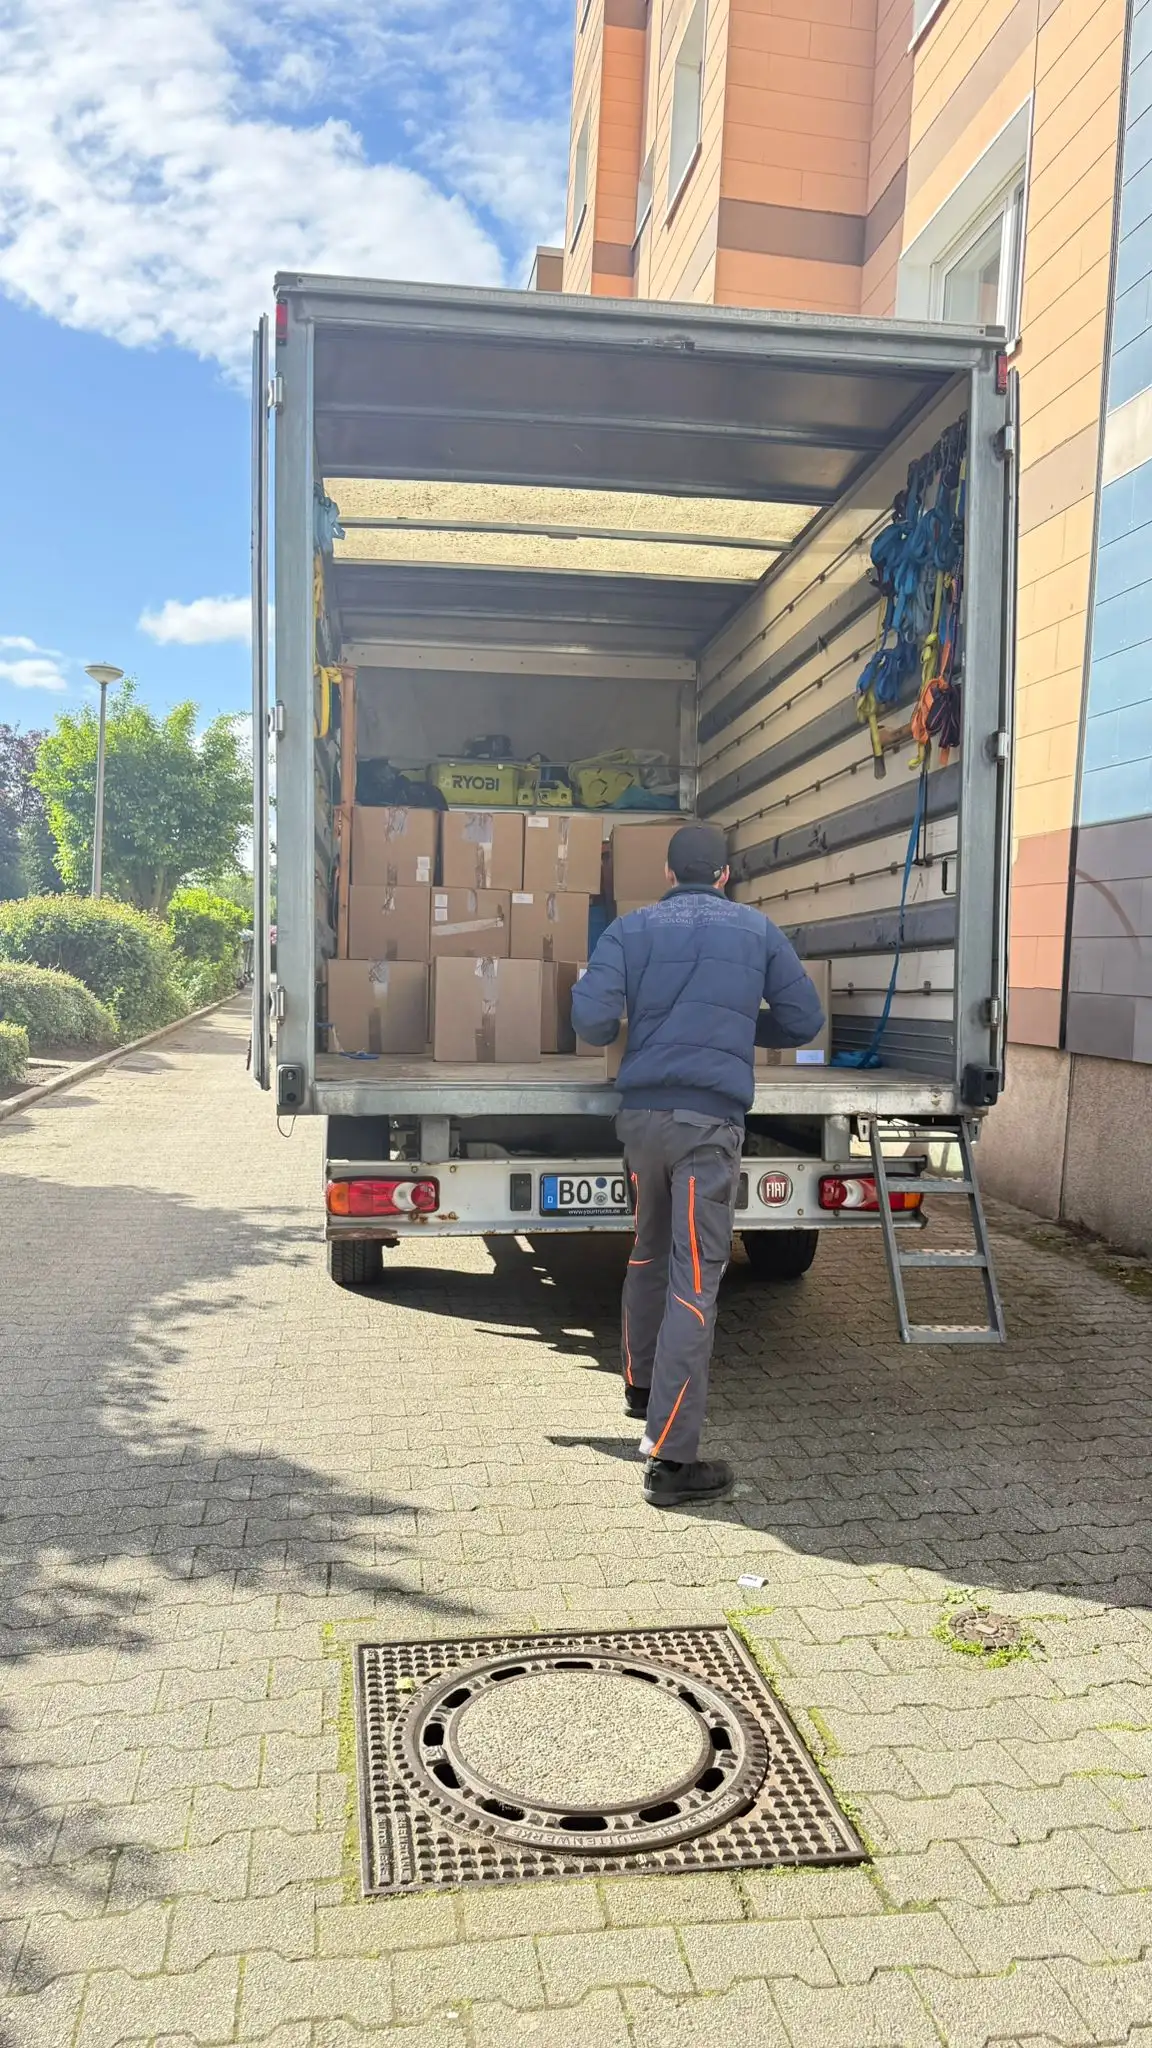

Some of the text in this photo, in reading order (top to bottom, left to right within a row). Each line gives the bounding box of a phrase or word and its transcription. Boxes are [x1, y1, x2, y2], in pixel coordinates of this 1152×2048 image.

[451, 774, 500, 792] RYOBI
[547, 1179, 626, 1205] D BO Q
[766, 1182, 786, 1198] FIAT
